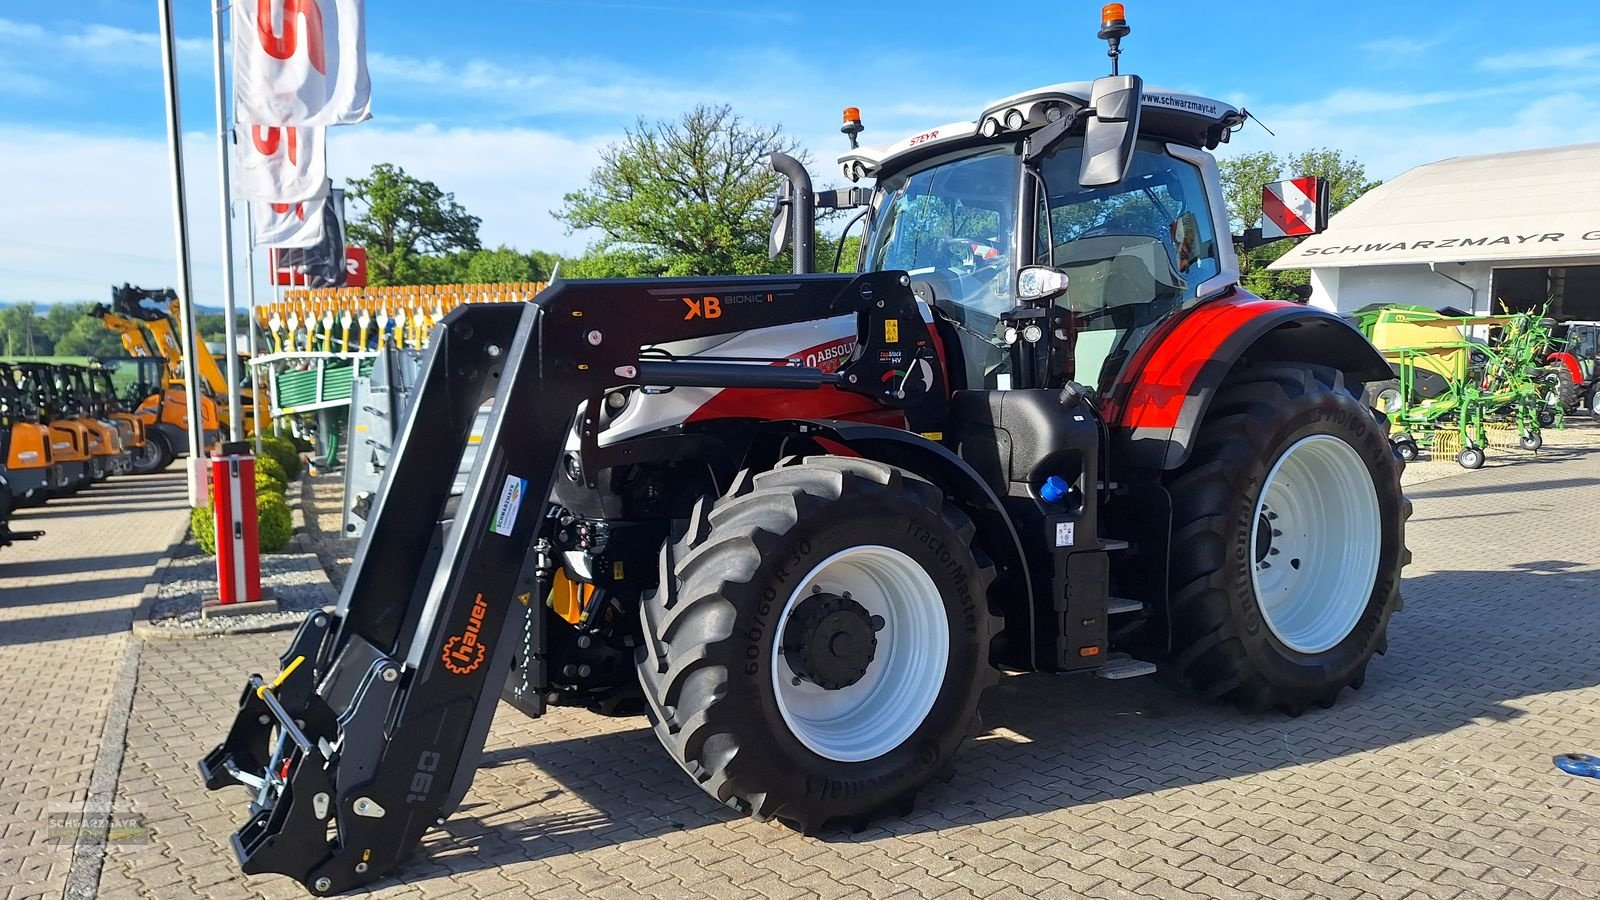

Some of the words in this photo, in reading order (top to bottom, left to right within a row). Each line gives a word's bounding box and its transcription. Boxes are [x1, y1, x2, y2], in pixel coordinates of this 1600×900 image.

[909, 130, 939, 146] STEYR
[1301, 232, 1565, 257] SCHWARZMAYR
[682, 296, 722, 320] XB
[724, 294, 763, 304] BIONIC
[817, 342, 855, 362] ABSOLU
[905, 518, 977, 635] TractorMaster
[451, 593, 488, 662] hauer
[744, 586, 777, 676] 600/60
[406, 750, 440, 803] 190
